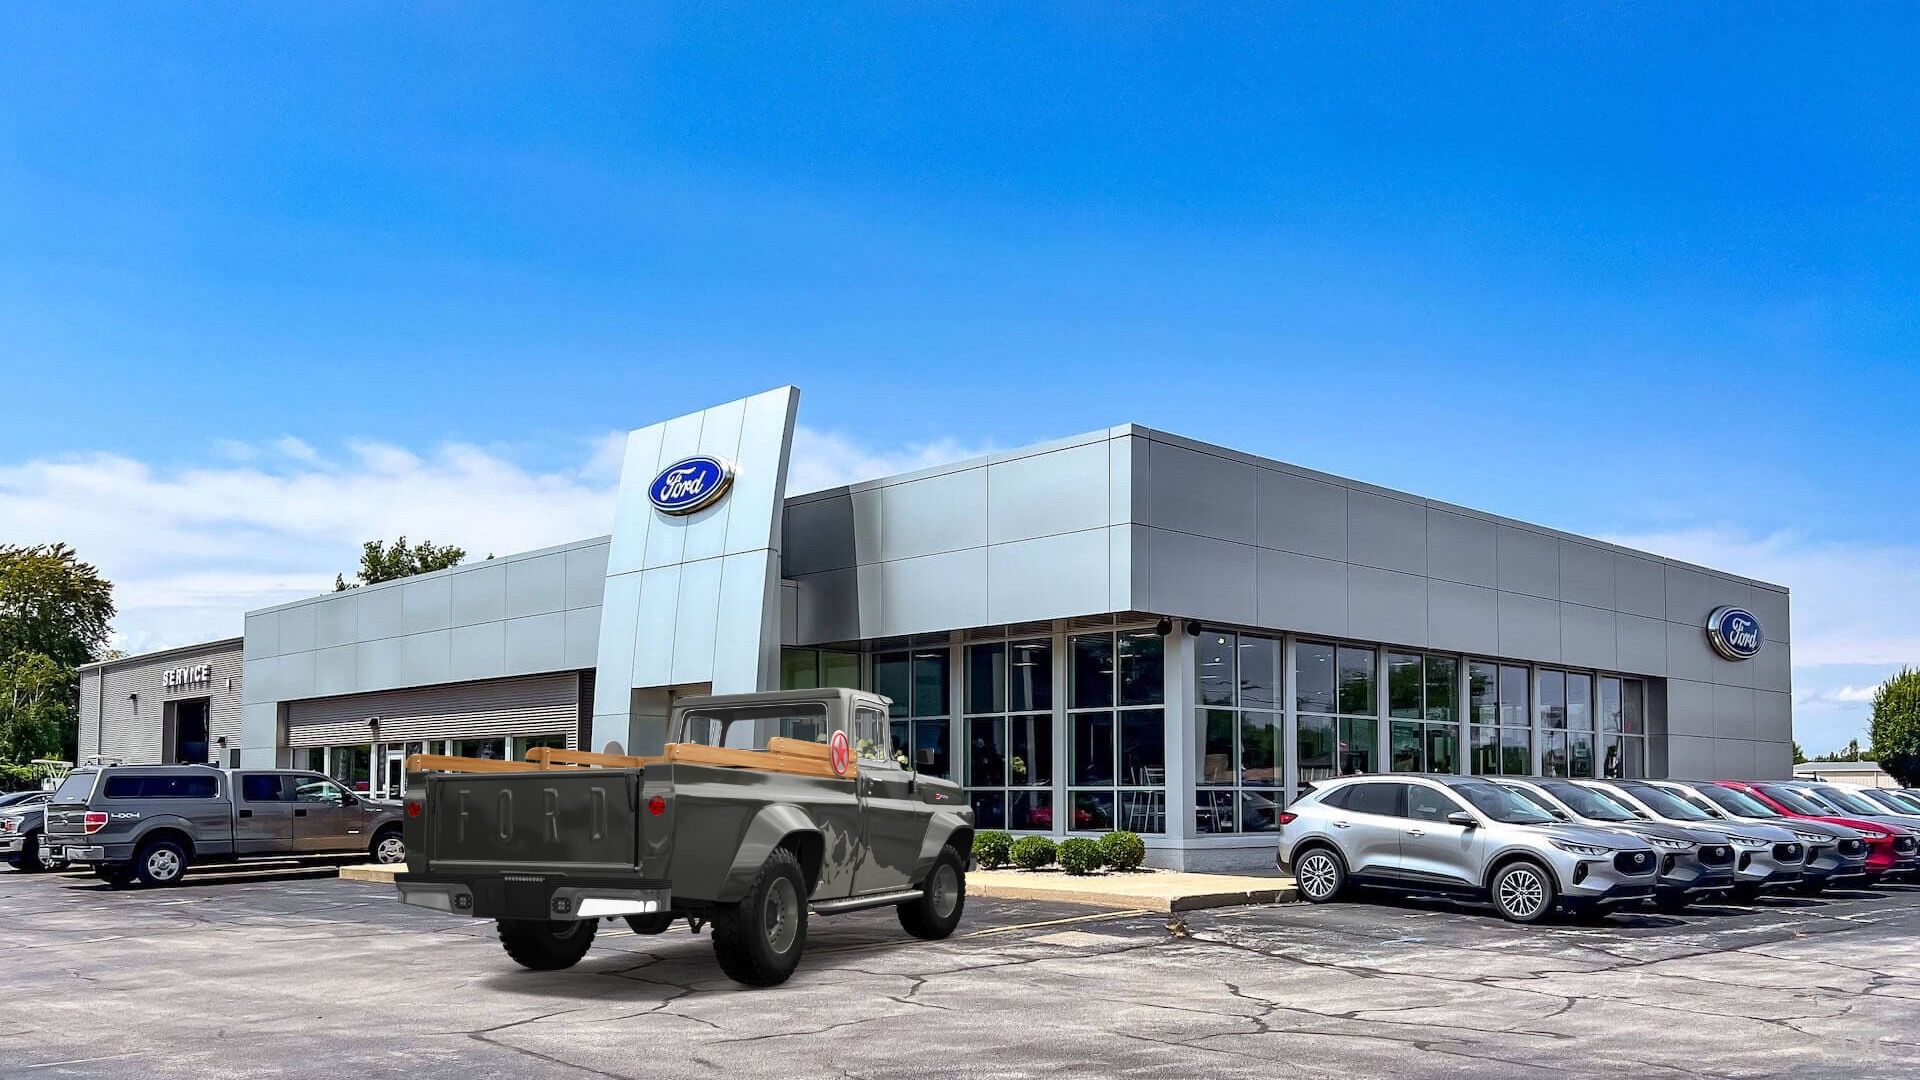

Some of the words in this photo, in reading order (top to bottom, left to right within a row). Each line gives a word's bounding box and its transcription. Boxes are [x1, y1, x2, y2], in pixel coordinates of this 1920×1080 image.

[661, 466, 706, 501] Ford
[1729, 617, 1758, 649] Ford
[162, 664, 209, 687] SERVICE
[458, 787, 607, 844] FORD
